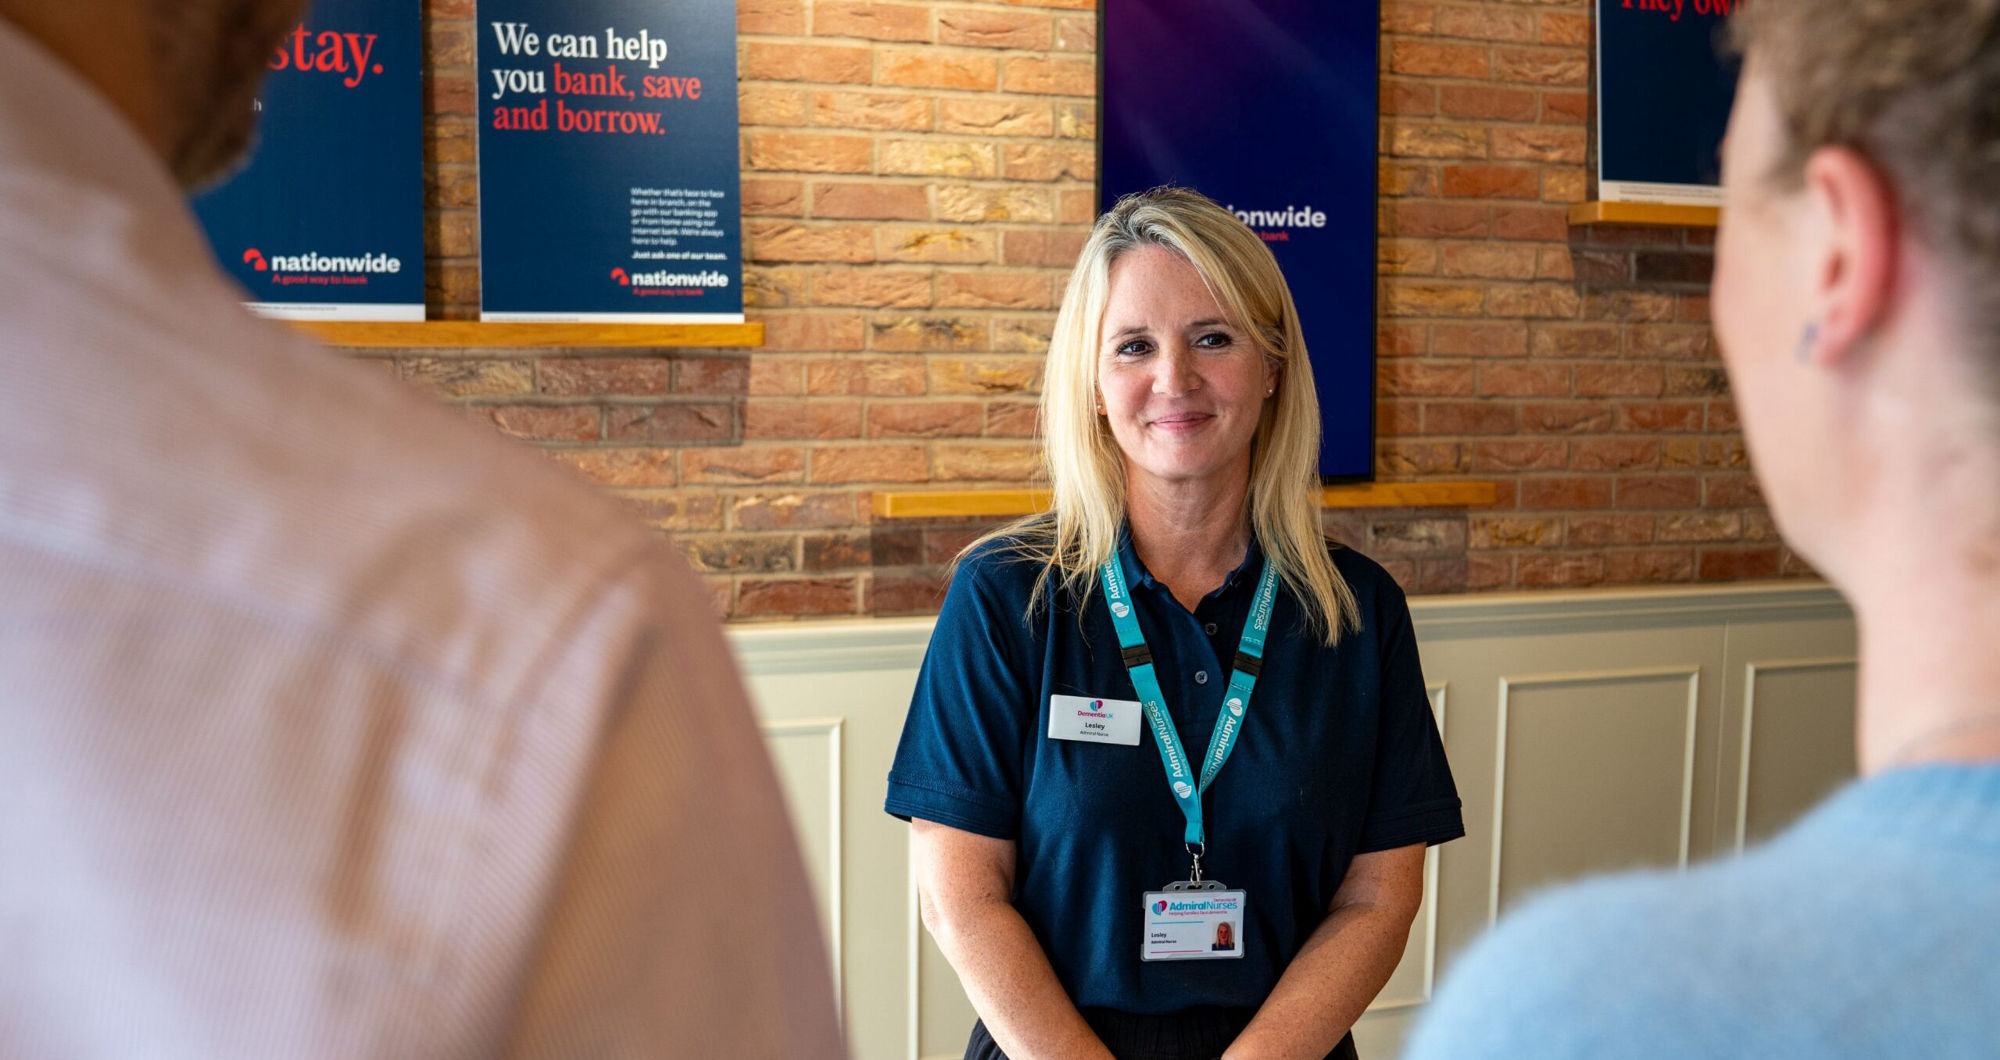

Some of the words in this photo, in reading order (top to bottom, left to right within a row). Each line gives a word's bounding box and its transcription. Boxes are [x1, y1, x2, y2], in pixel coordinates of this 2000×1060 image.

[1622, 0, 1684, 21] ey
[491, 21, 540, 56] We
[547, 33, 599, 58] can
[605, 27, 668, 69] help
[491, 69, 547, 100] you
[554, 61, 636, 100] bank,
[643, 75, 702, 100] save
[493, 98, 549, 131] and
[557, 100, 667, 136] borrow.
[1227, 204, 1327, 228] onwide
[271, 251, 401, 273] nationwide
[272, 274, 281, 283] A
[631, 269, 729, 287] nationwide
[1085, 722, 1106, 730] Lesley
[1147, 700, 1183, 777] AdmiralNurses
[1202, 715, 1237, 784] AdmiralNur
[1169, 900, 1238, 911] AdmiralNurses
